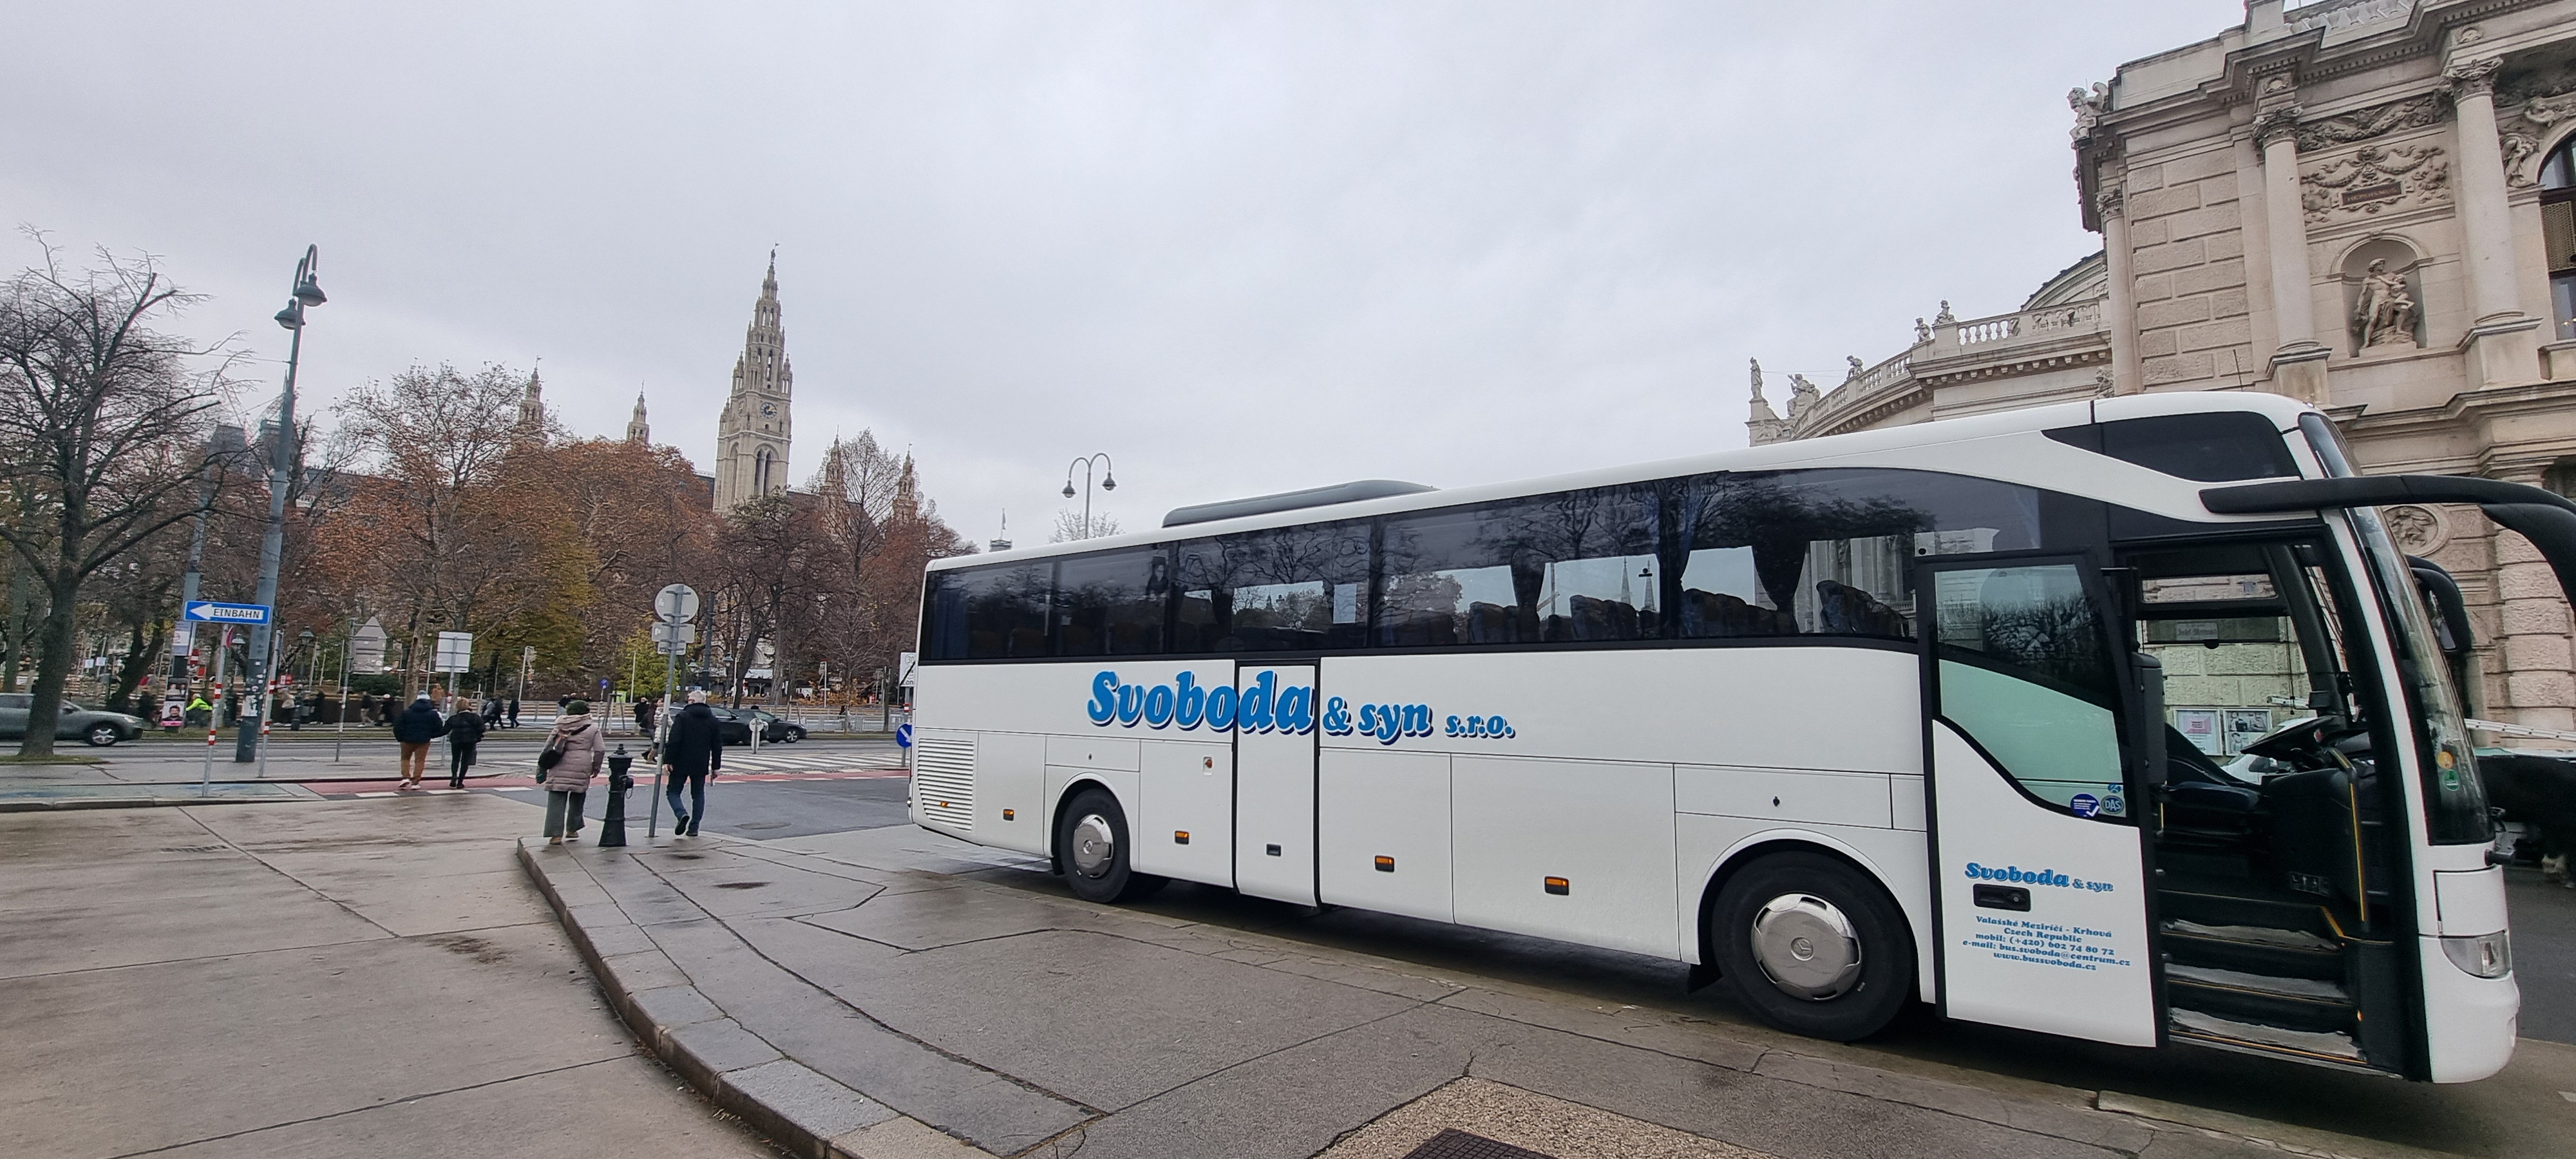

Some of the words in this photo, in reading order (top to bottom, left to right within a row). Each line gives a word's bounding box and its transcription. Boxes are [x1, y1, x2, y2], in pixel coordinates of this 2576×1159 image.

[214, 608, 260, 618] EINBAHN
[1087, 670, 1314, 735] Svoboda
[1322, 696, 1353, 736] &
[1357, 704, 1434, 745] syn
[1444, 715, 1515, 739] s.r.o.
[2105, 799, 2121, 811] DAS
[1965, 862, 2070, 887] Svoboda
[2072, 878, 2085, 889] &
[2086, 881, 2114, 892] syn
[2004, 927, 2032, 937] Czech
[2036, 931, 2082, 943] Republic
[2073, 927, 2112, 938] Krhová
[1976, 934, 2006, 942] mobil:
[2009, 936, 2044, 947] (+420)
[2048, 941, 2067, 950] 602
[1962, 940, 1996, 949] e-mail:
[2000, 943, 2130, 966] bus.svoboda@centrum.cz
[1993, 953, 2096, 970] www.bussvoboda.cz
